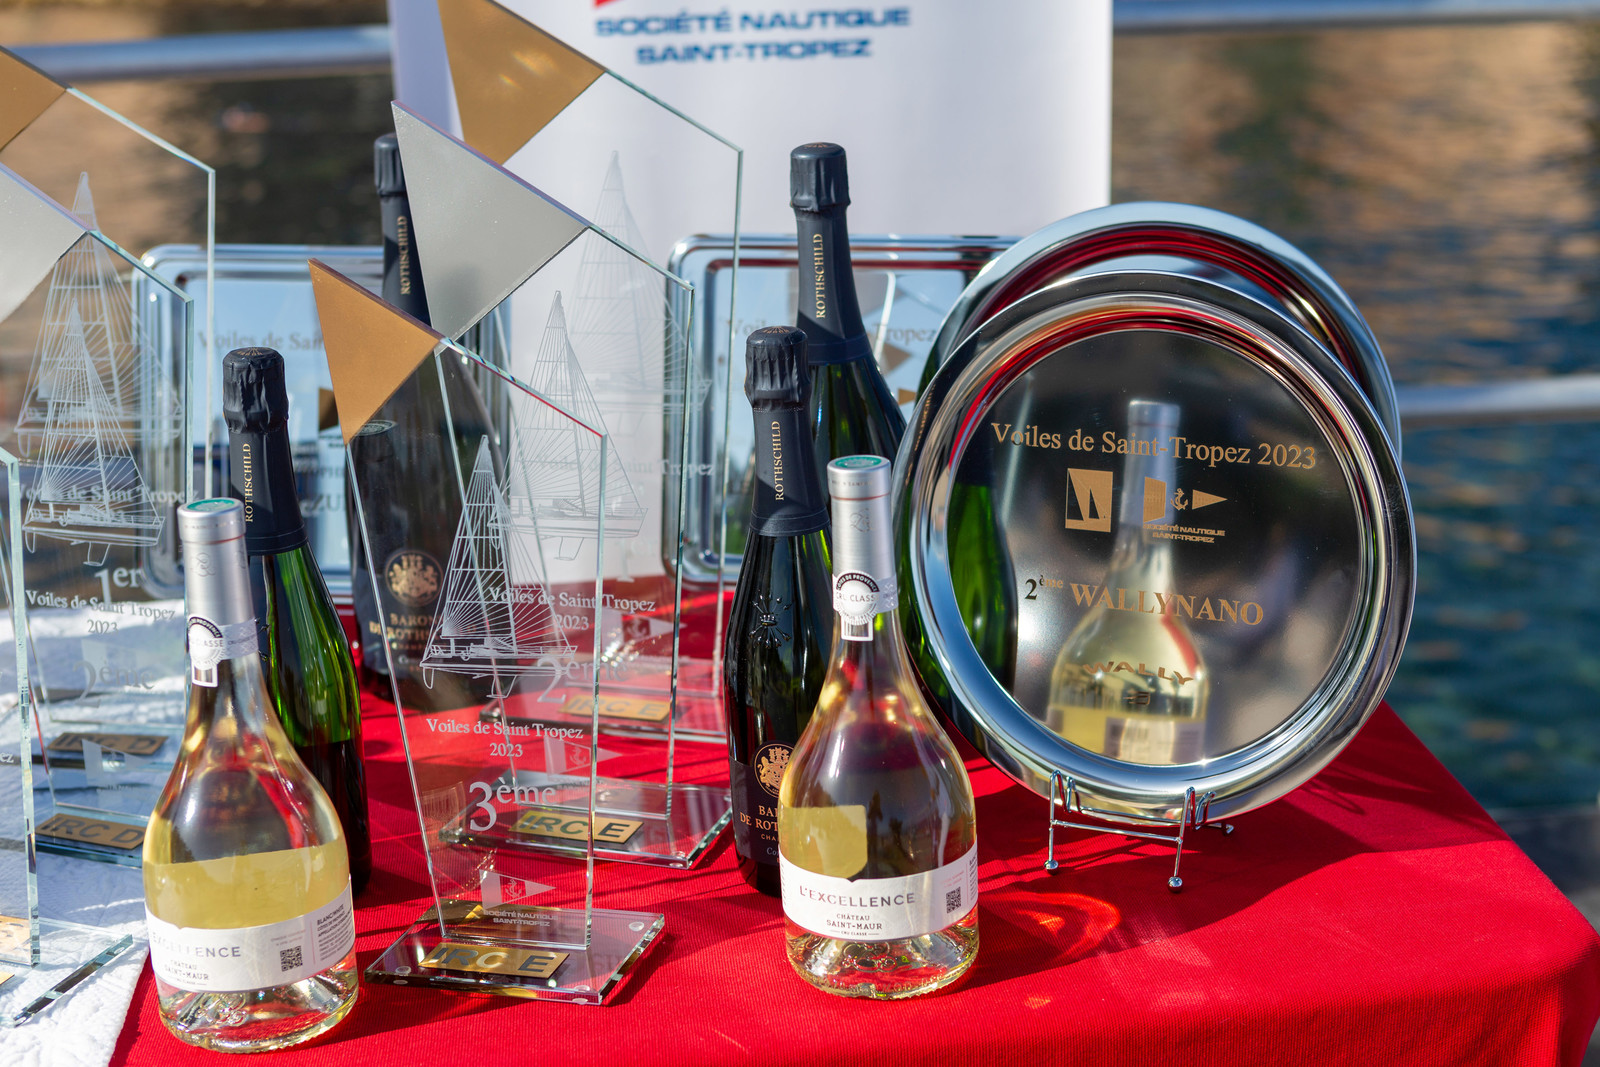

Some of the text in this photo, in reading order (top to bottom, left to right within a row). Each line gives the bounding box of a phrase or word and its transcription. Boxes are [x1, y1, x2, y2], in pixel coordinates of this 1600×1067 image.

[597, 6, 910, 36] SOCIÉTÉ NAUTIQUE
[636, 38, 872, 65] SAINT-TROPEZ
[397, 216, 411, 295] ROTHSCHILD
[812, 233, 827, 319] ROTHSCHILD
[262, 331, 284, 349] de
[990, 422, 1317, 470] Voiles de Saint-Tropez 2023
[771, 420, 785, 501] ROTHSCHILD
[242, 443, 254, 523] ROTHSCHILD
[1152, 531, 1215, 543] SAINT-TROPEZ
[1180, 526, 1226, 537] NAUTIQUE
[26, 589, 68, 609] Voiles
[71, 595, 87, 609] de
[130, 601, 176, 622] Tropez
[560, 592, 597, 609] Saint
[602, 594, 656, 614] Tropez
[1070, 582, 1265, 626] WALLYNANO
[87, 619, 119, 635] 2023
[556, 614, 590, 631] 2023
[1082, 660, 1195, 686] WALLY
[638, 702, 663, 717] E
[426, 718, 584, 740] Voiles de Saint Tropez
[490, 743, 524, 758] 2023
[469, 776, 558, 832] 3ème
[41, 816, 145, 845] IRC D
[523, 814, 631, 839] IRC E
[740, 811, 752, 827] DE
[799, 884, 916, 908] L'EXCELLENCE
[826, 919, 883, 931] SAINT-MAUR
[432, 947, 556, 973] IRC E
